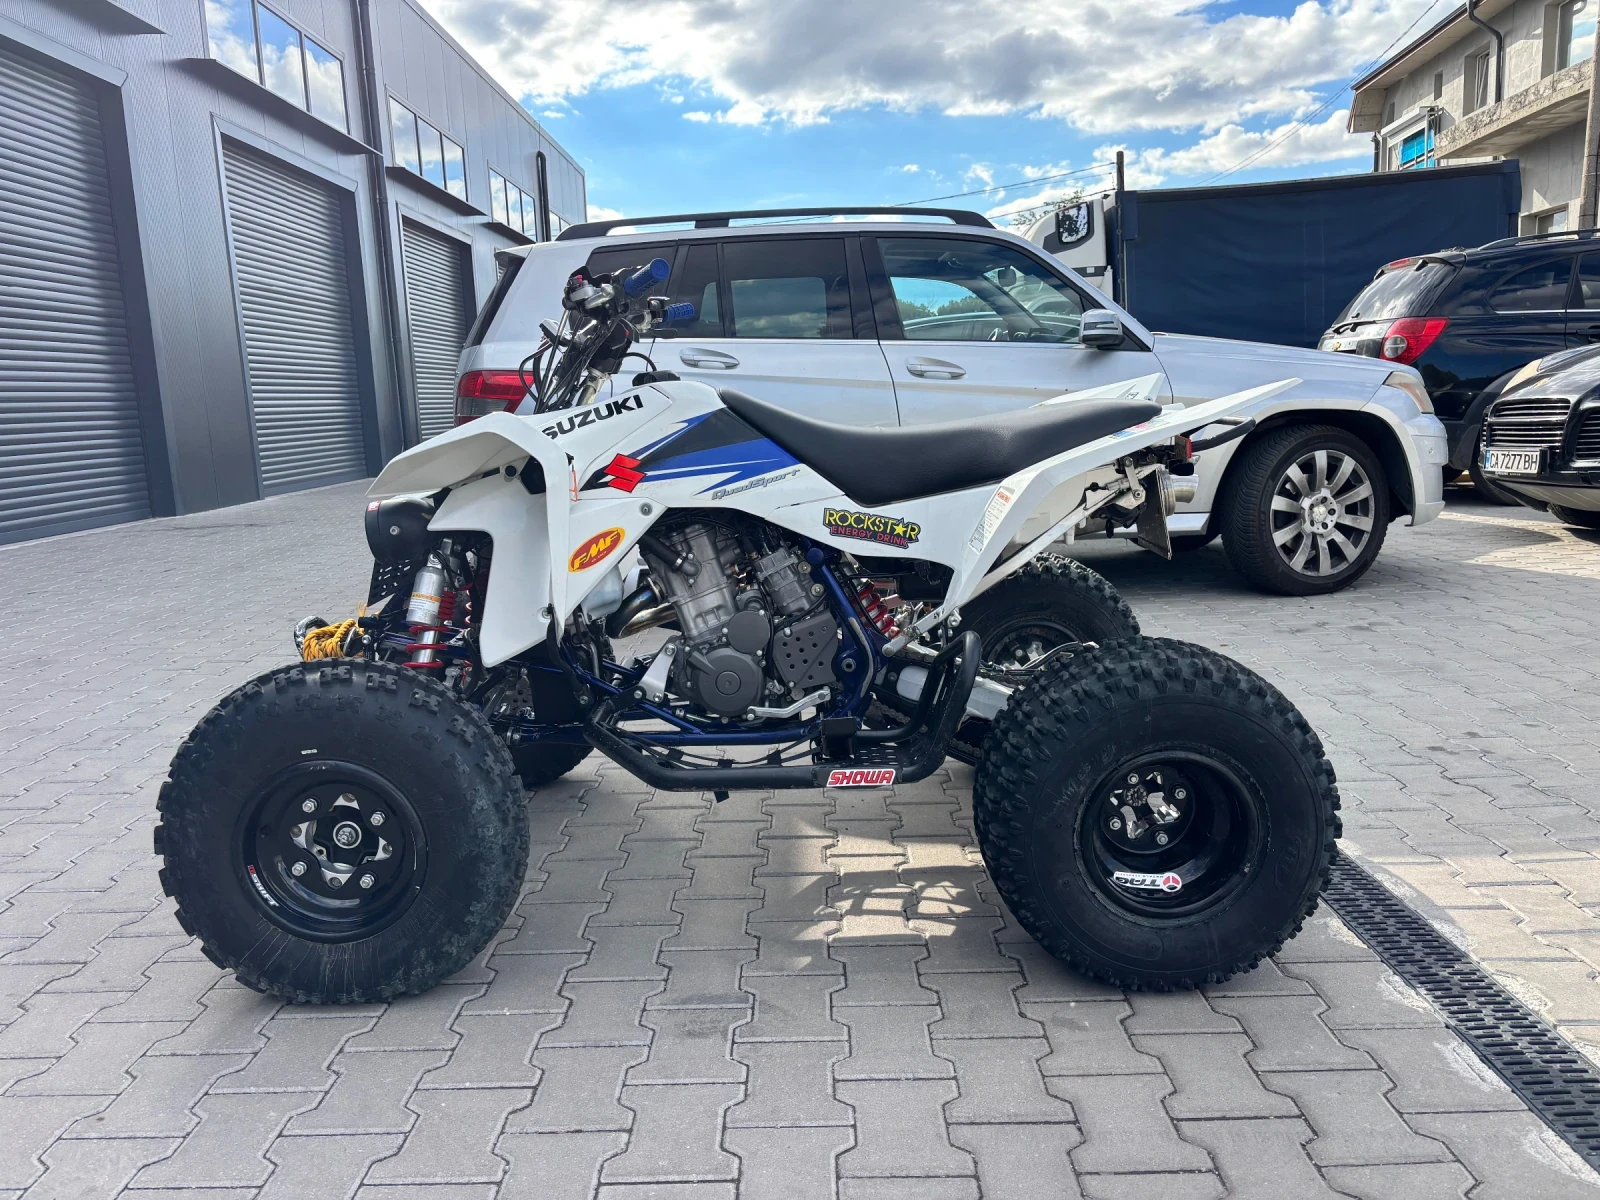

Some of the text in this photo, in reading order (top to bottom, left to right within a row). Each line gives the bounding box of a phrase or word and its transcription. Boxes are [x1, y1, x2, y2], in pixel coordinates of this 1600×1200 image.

[541, 394, 644, 440] SUZUKI
[1490, 453, 1538, 470] CA 7277 BH
[831, 525, 908, 547] ENERGY DRINK
[573, 530, 619, 571] FMF
[828, 770, 894, 786] SHOWA
